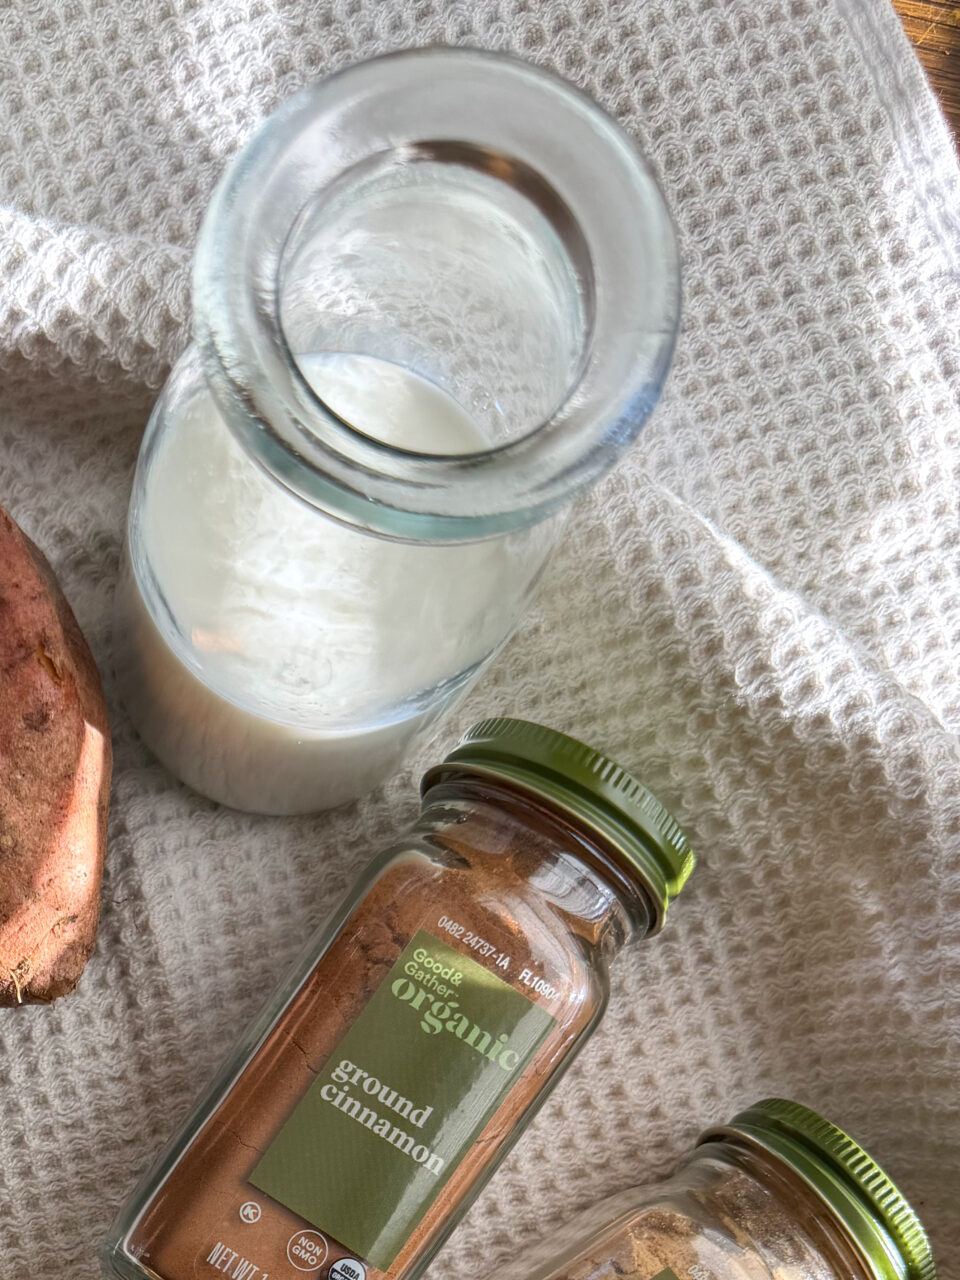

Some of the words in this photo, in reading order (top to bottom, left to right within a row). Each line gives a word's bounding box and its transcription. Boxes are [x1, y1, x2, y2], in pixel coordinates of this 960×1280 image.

[437, 915, 465, 939] 0482
[461, 931, 511, 970] 24737-1A
[391, 978, 519, 1071] organic
[331, 1059, 434, 1129] ground
[320, 1084, 445, 1176] cinnamon
[206, 1241, 239, 1273] NET
[292, 1246, 317, 1266] GMO
[298, 1236, 323, 1256] NON
